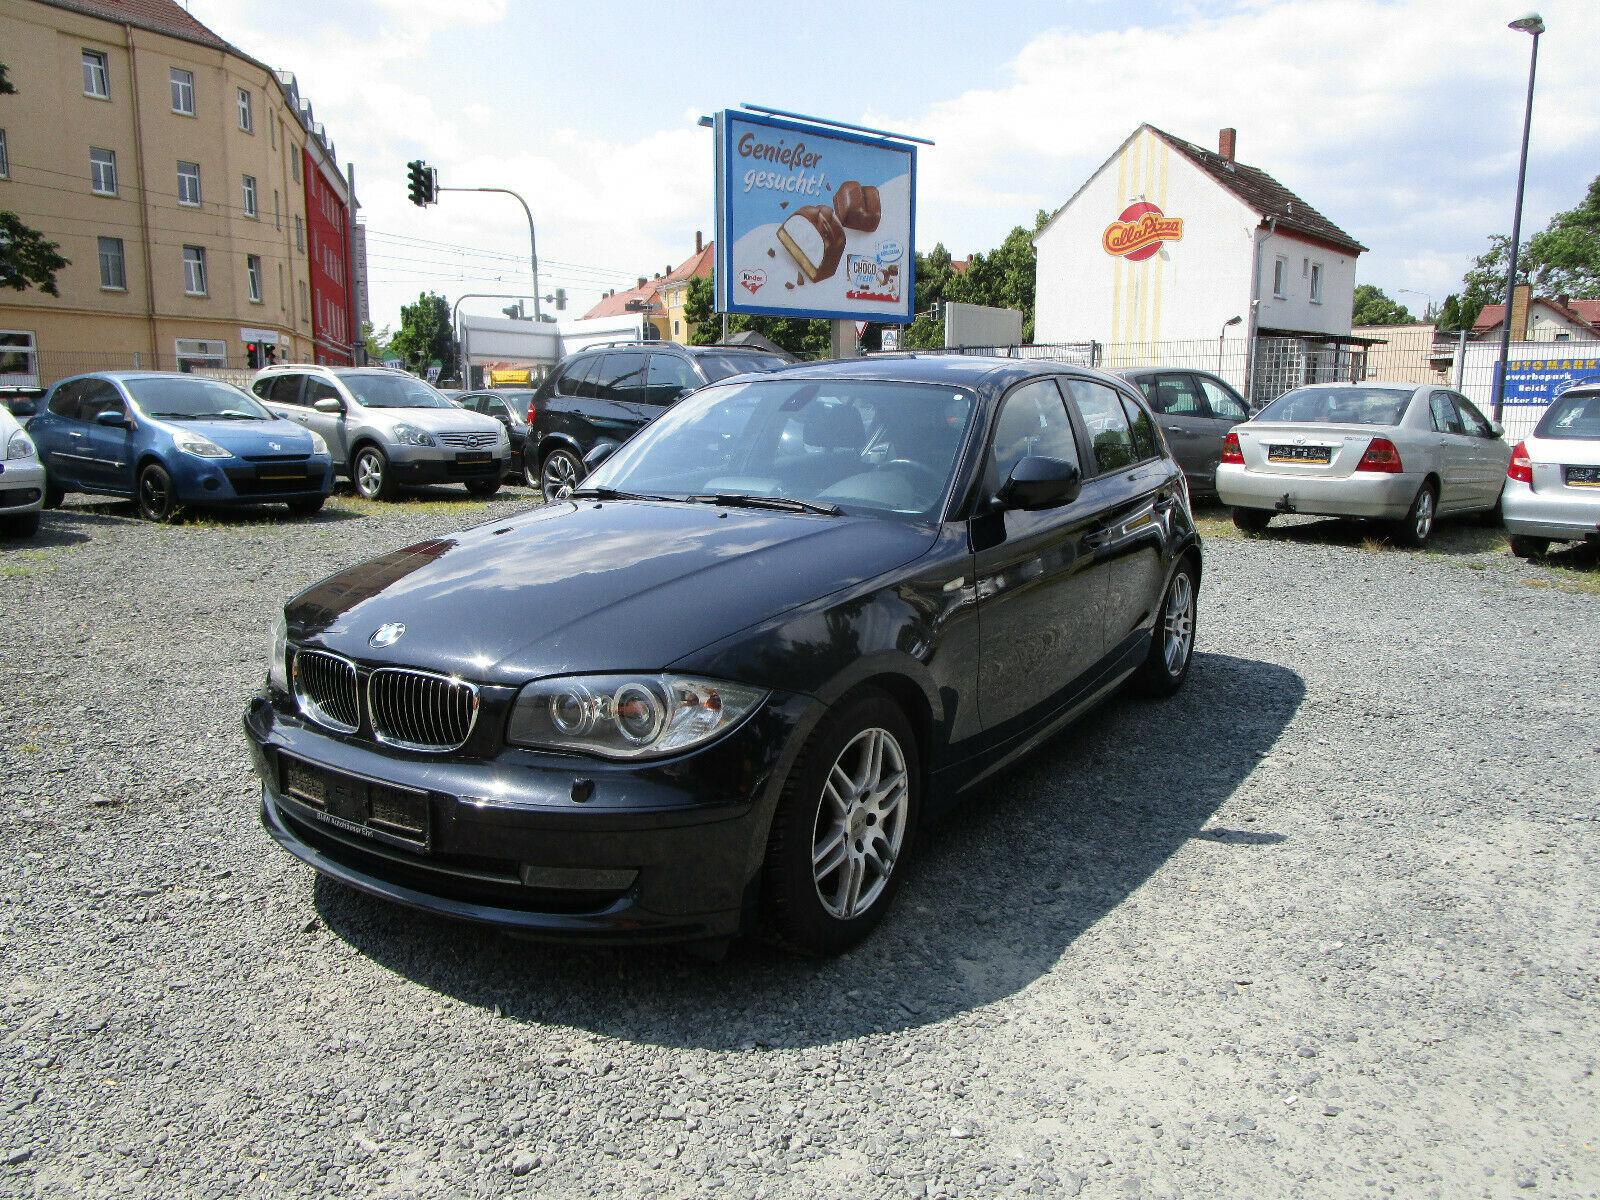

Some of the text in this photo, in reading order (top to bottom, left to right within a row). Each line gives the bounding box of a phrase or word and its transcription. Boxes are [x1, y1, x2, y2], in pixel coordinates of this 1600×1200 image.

[737, 132, 823, 171] Genießer
[743, 168, 826, 197] gesucht!
[853, 262, 877, 275] CHOCO
[1505, 372, 1572, 381] ewerbepark
[1519, 384, 1548, 392] Reick
[1531, 396, 1549, 404] Str.
